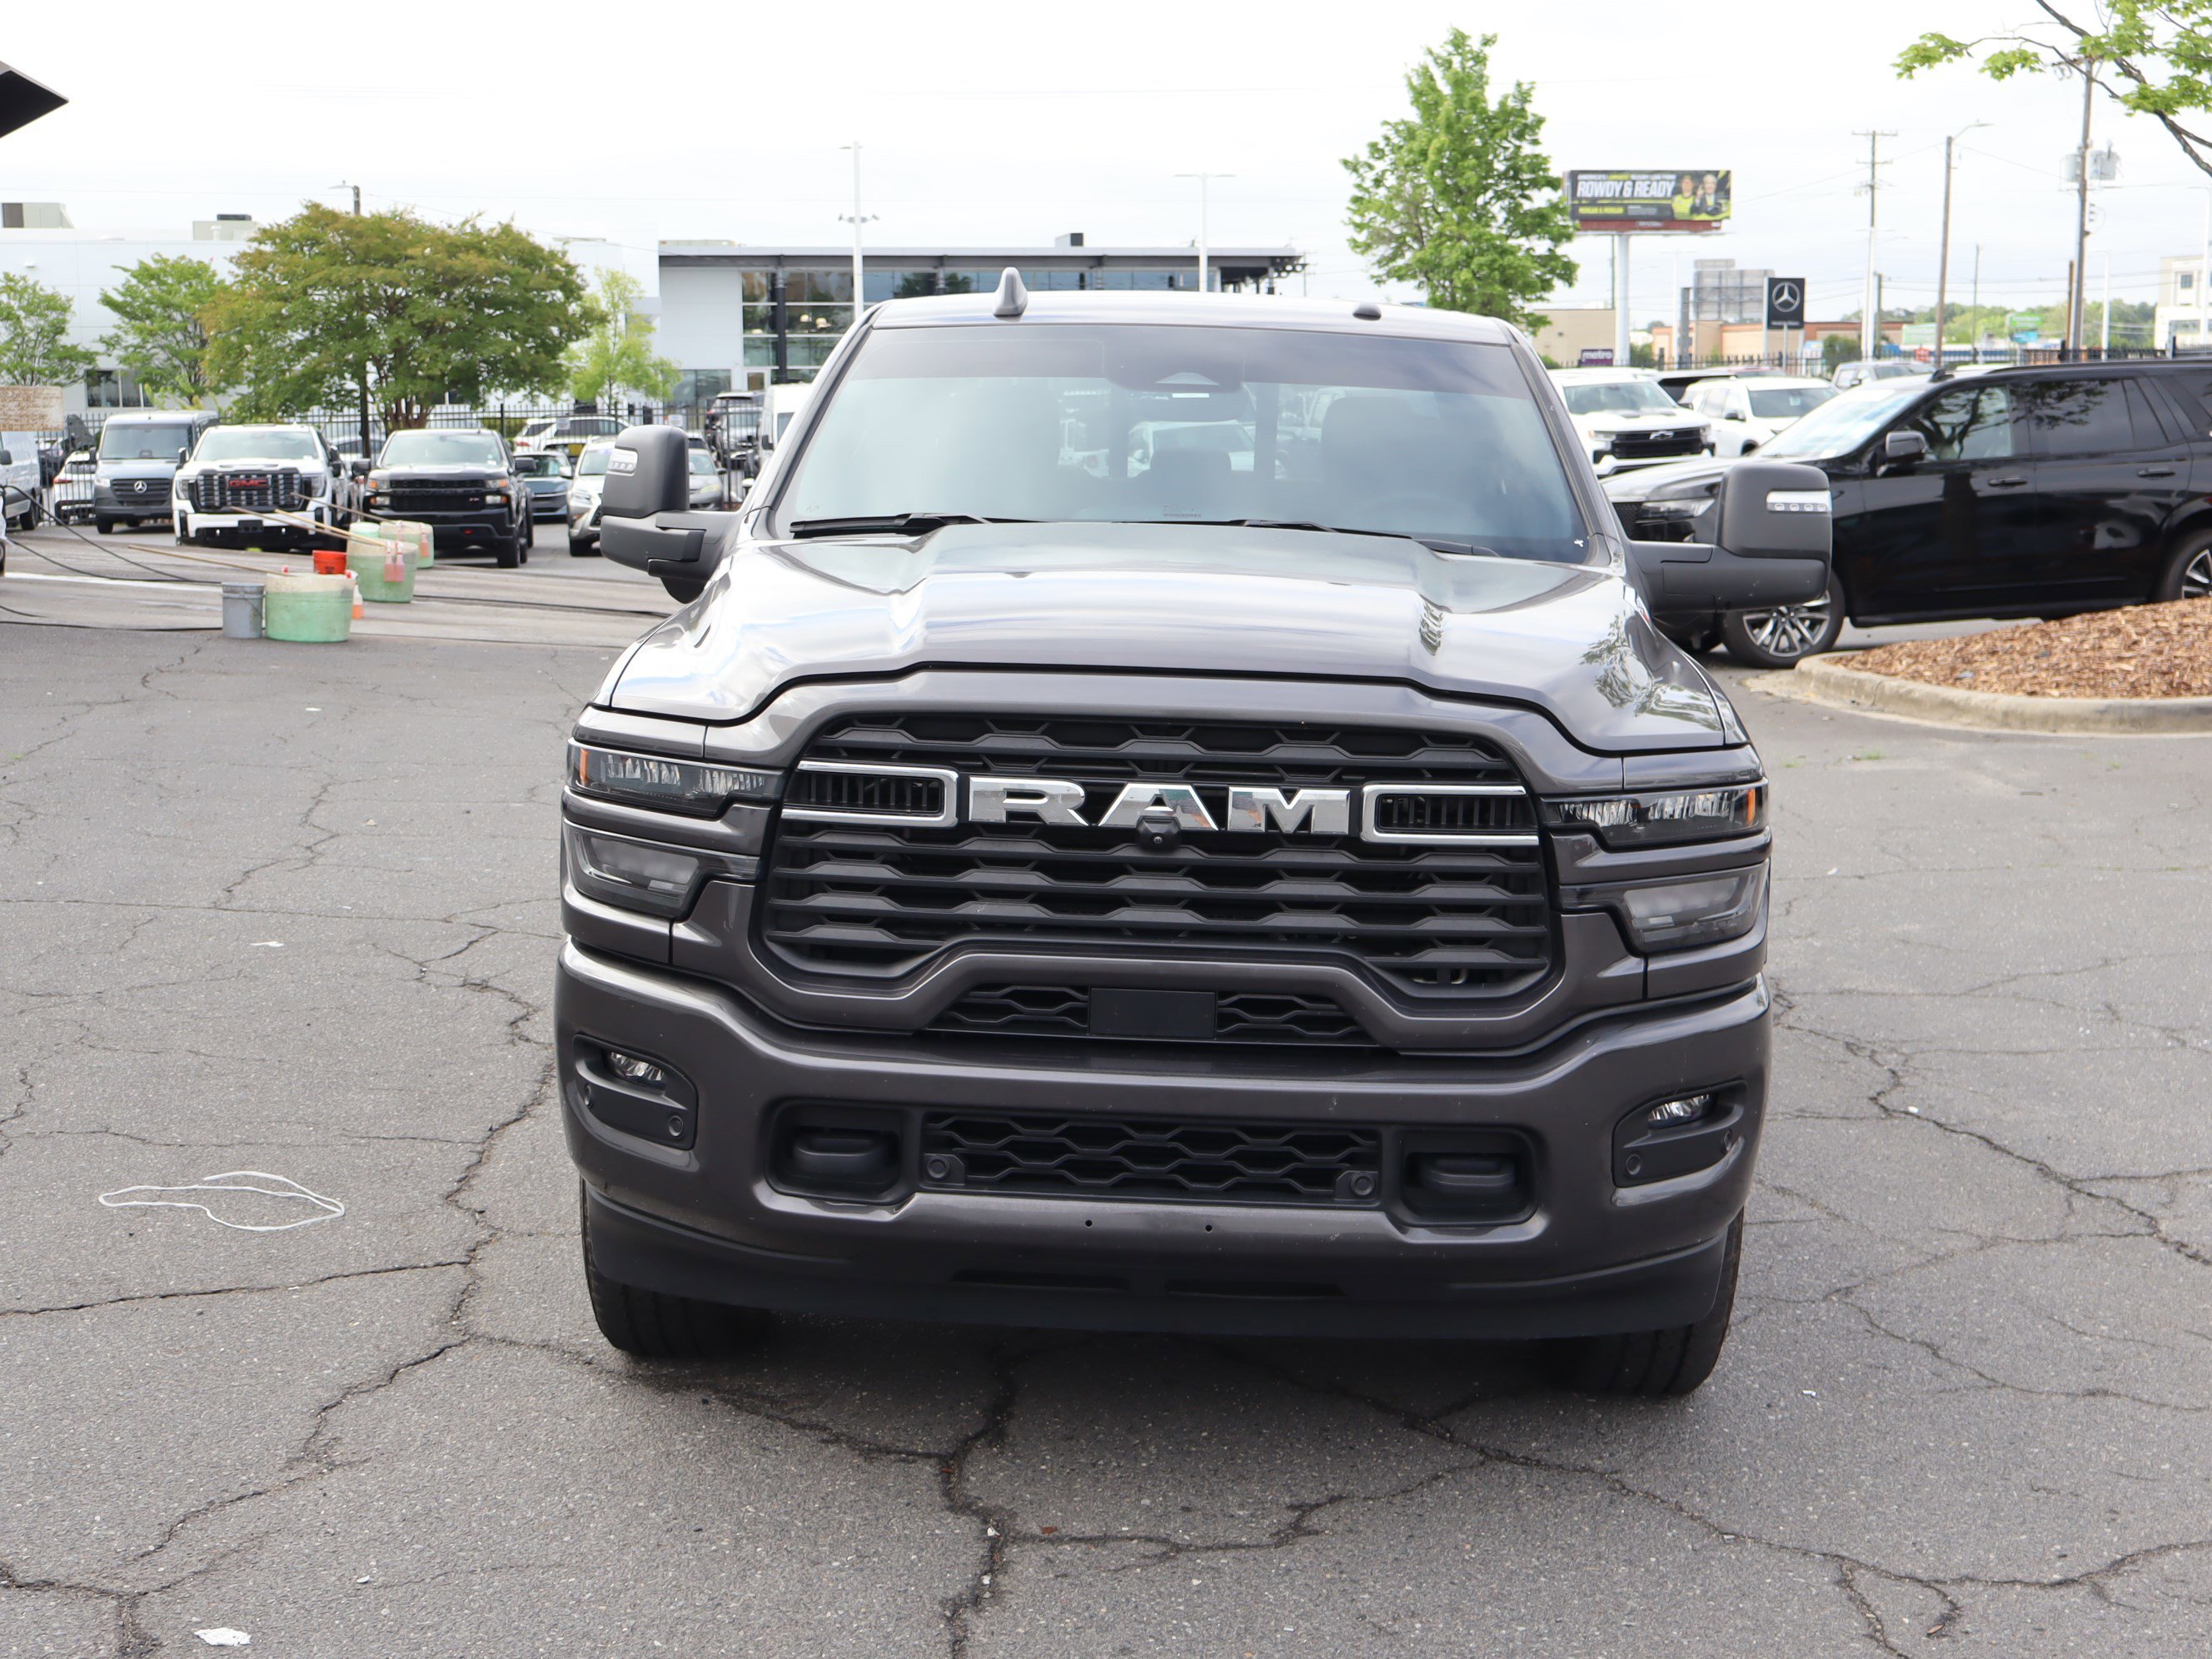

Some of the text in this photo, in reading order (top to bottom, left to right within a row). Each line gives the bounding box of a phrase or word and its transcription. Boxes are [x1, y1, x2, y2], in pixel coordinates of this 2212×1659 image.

[1577, 180, 1623, 198] ROWDY
[1633, 180, 1676, 198] READY
[1582, 350, 1612, 360] metro
[229, 479, 267, 488] GMC
[969, 775, 1352, 834] RAM
